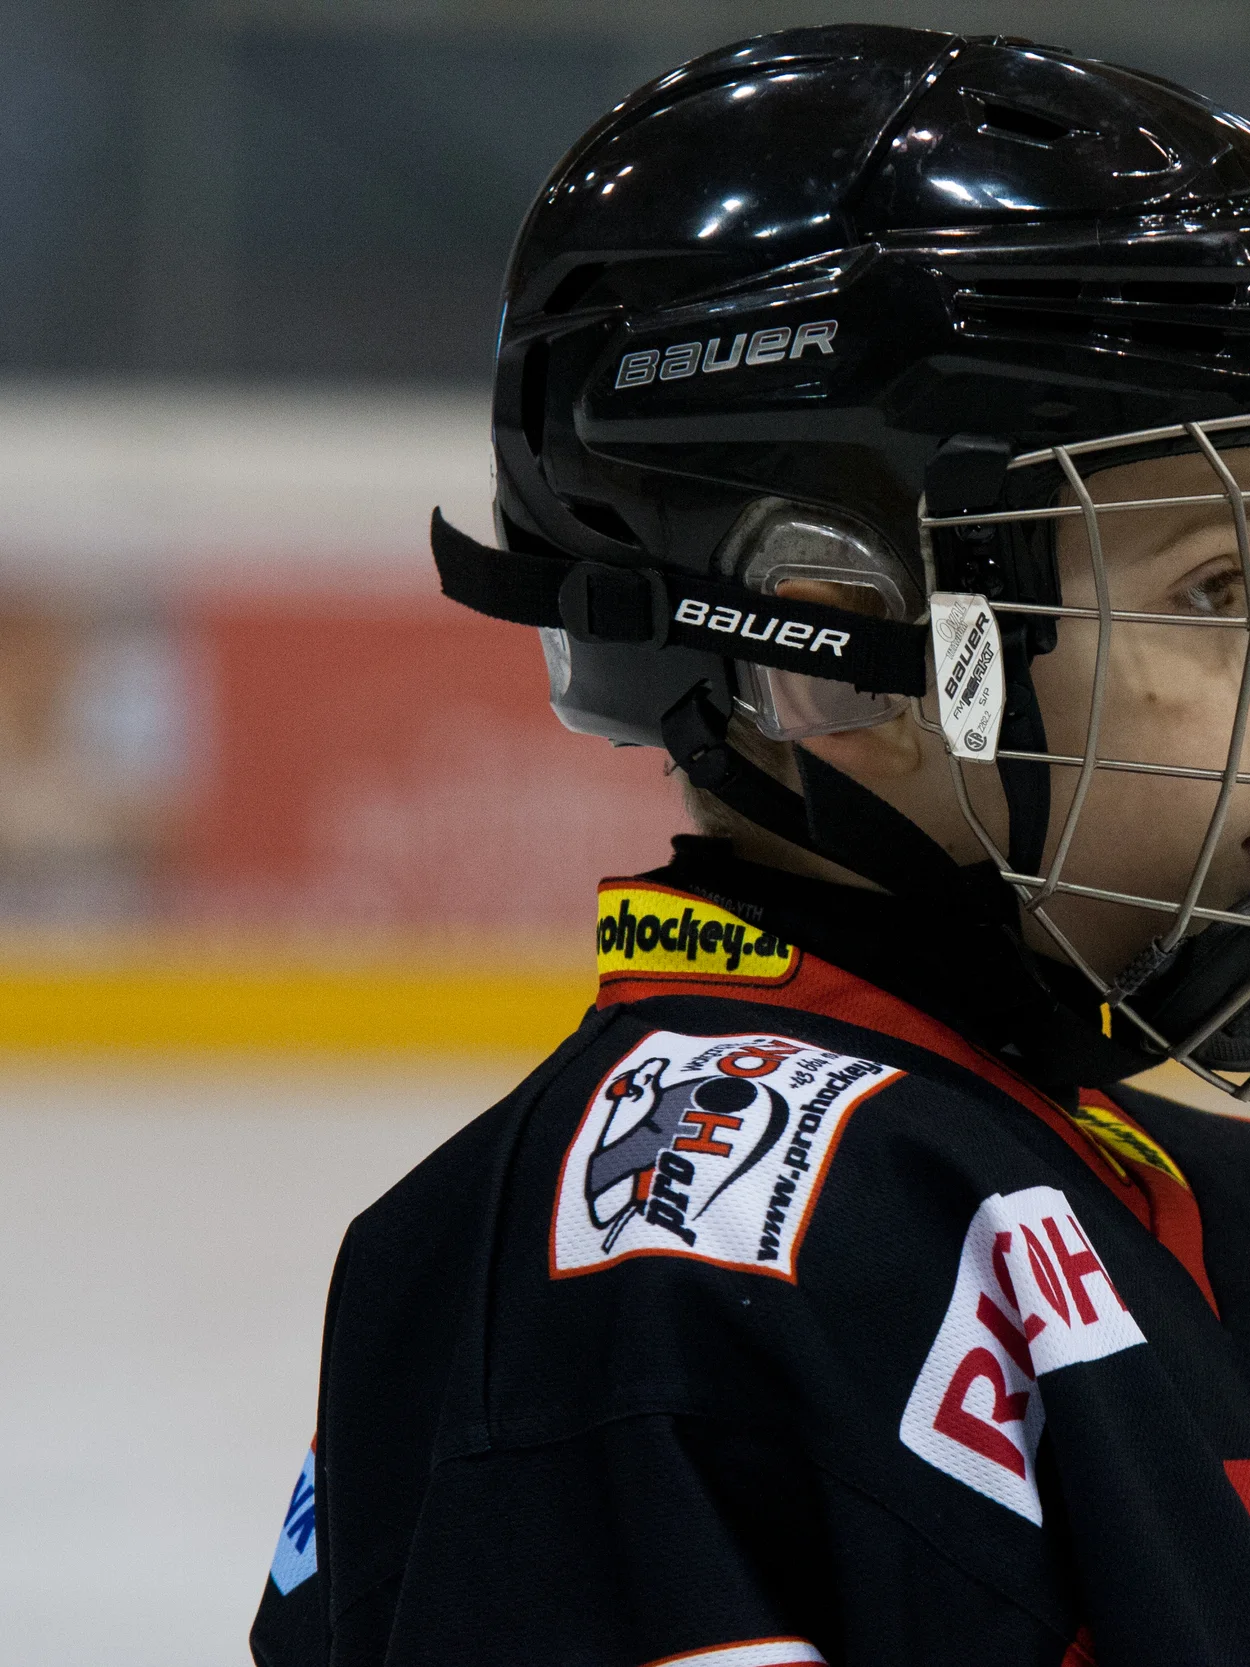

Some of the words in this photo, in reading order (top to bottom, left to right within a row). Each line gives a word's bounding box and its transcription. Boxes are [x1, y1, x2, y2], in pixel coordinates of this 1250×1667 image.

[614, 319, 839, 389] BAUER
[674, 598, 851, 657] BAUER
[944, 611, 990, 700] BAUER
